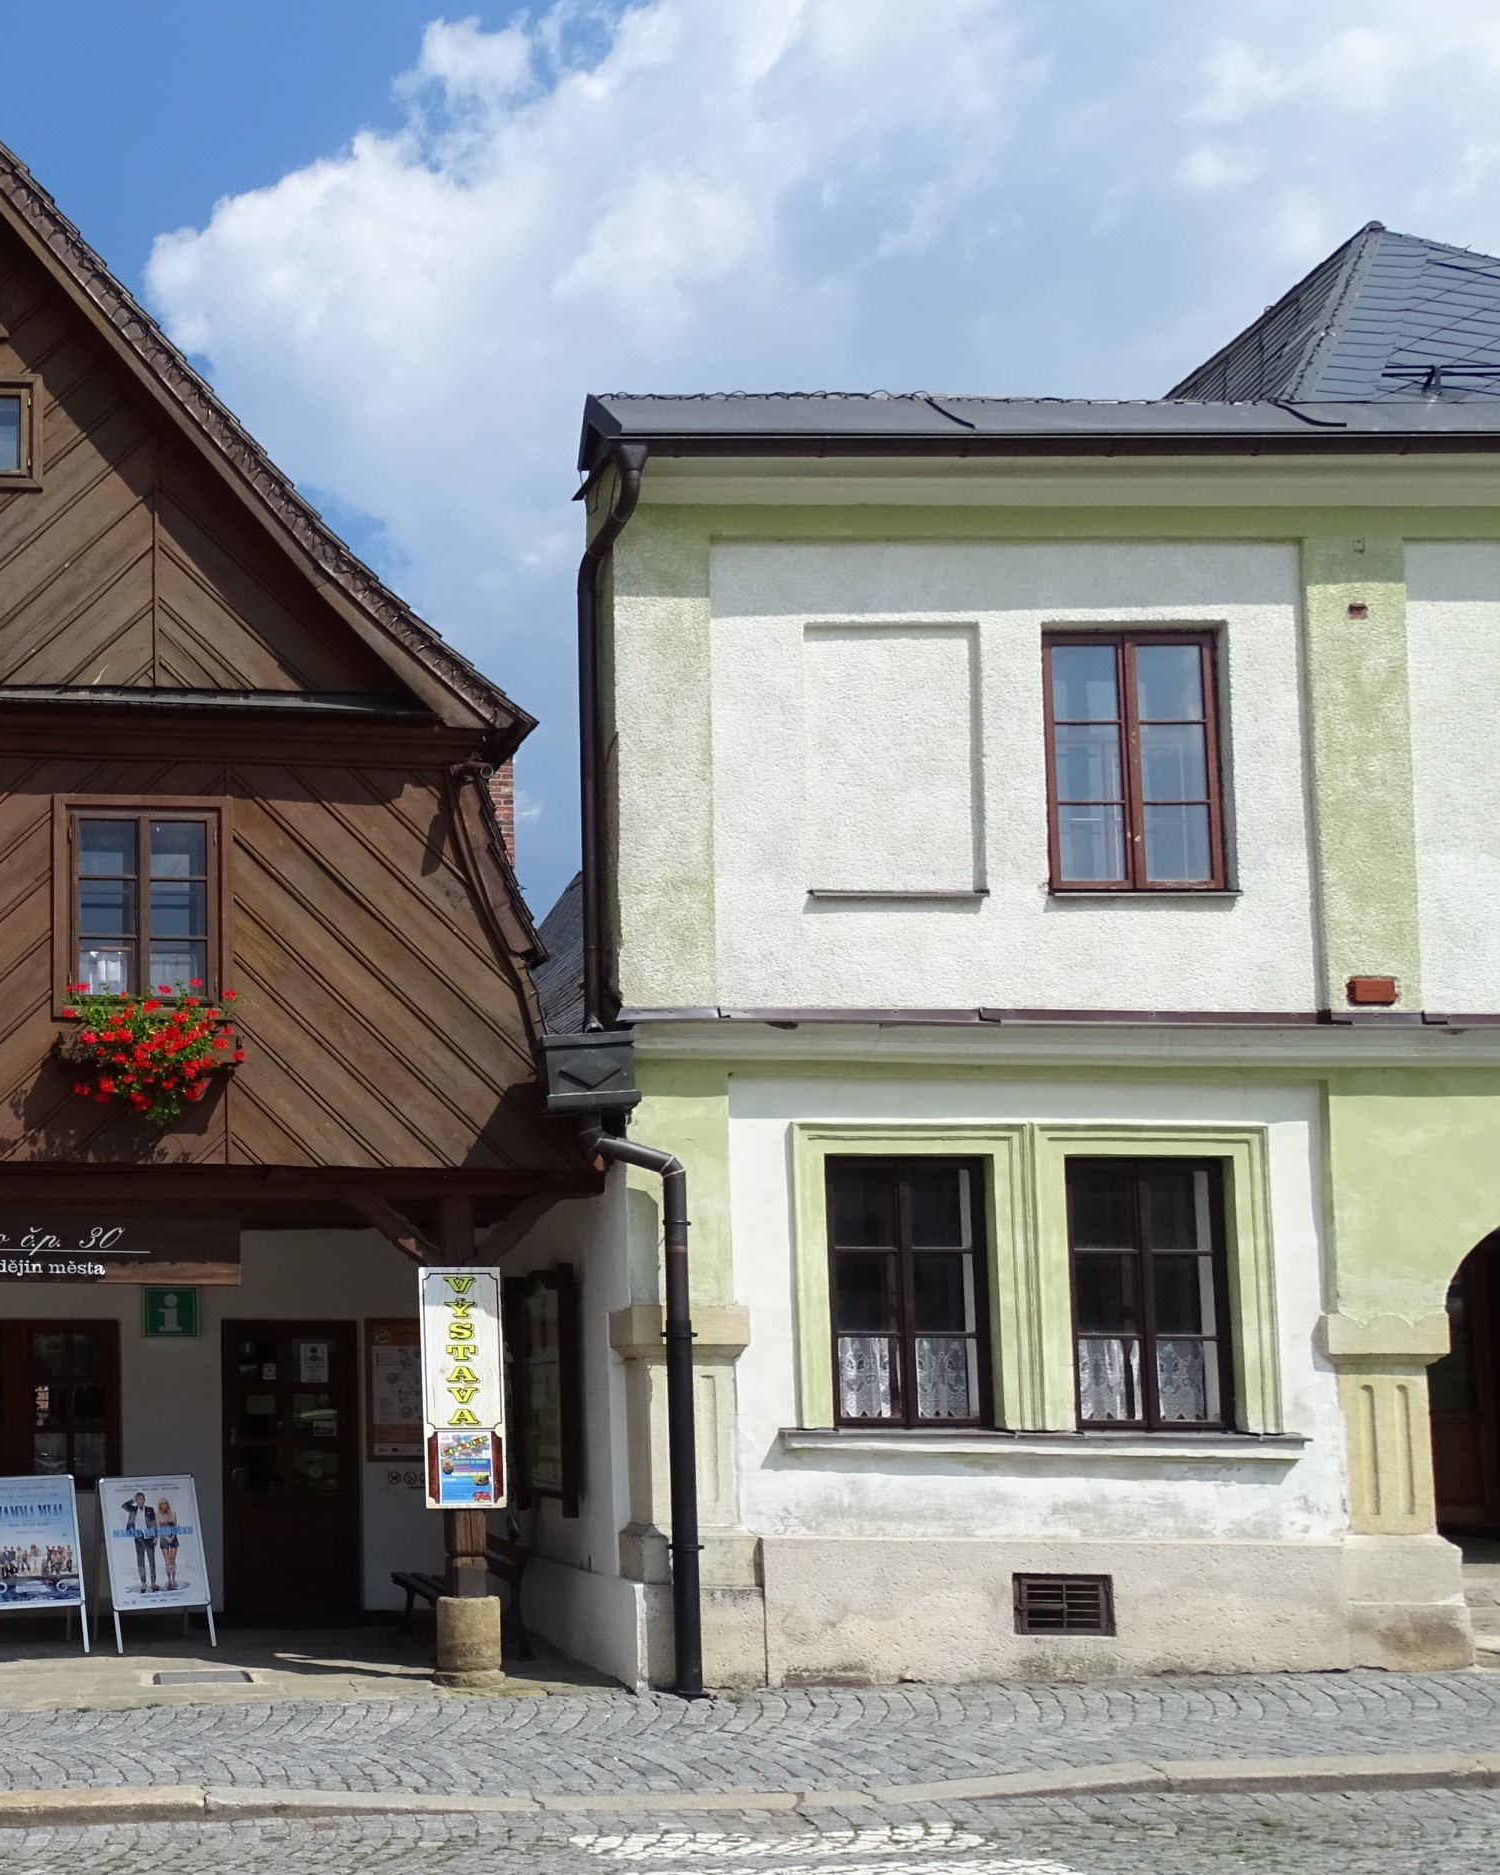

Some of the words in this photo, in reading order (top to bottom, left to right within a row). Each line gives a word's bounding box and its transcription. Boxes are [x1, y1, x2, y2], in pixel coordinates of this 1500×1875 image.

[20, 1226, 61, 1256] č.p.
[79, 1226, 126, 1249] 30
[48, 1260, 106, 1275] města
